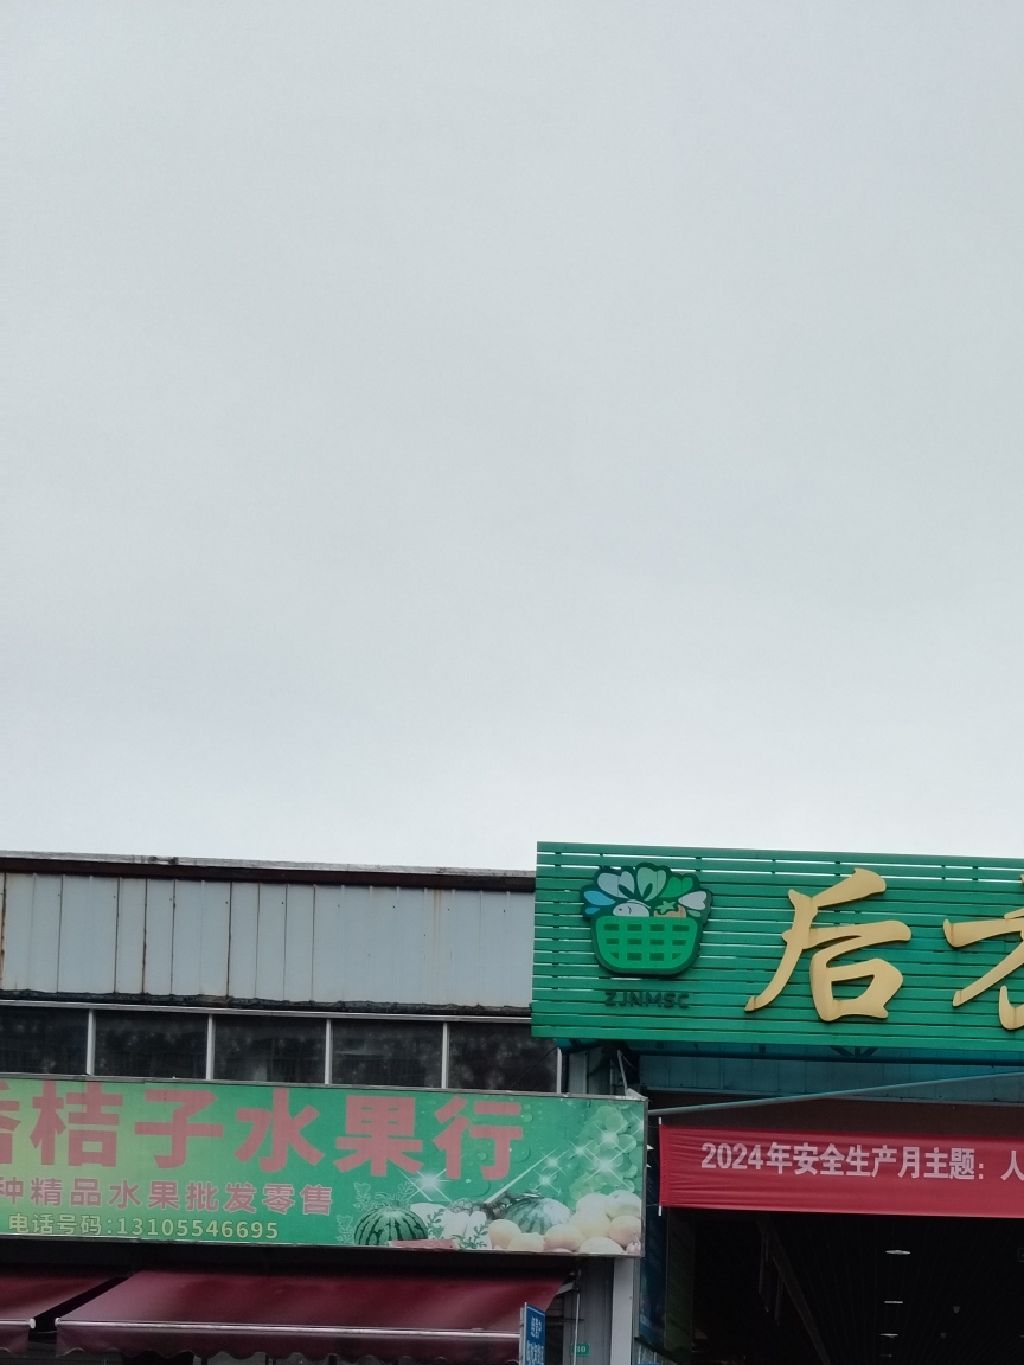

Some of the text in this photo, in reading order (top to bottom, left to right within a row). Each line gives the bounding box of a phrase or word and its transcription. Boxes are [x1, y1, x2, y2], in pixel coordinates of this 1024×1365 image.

[0, 1079, 523, 1181] 桔子水果行
